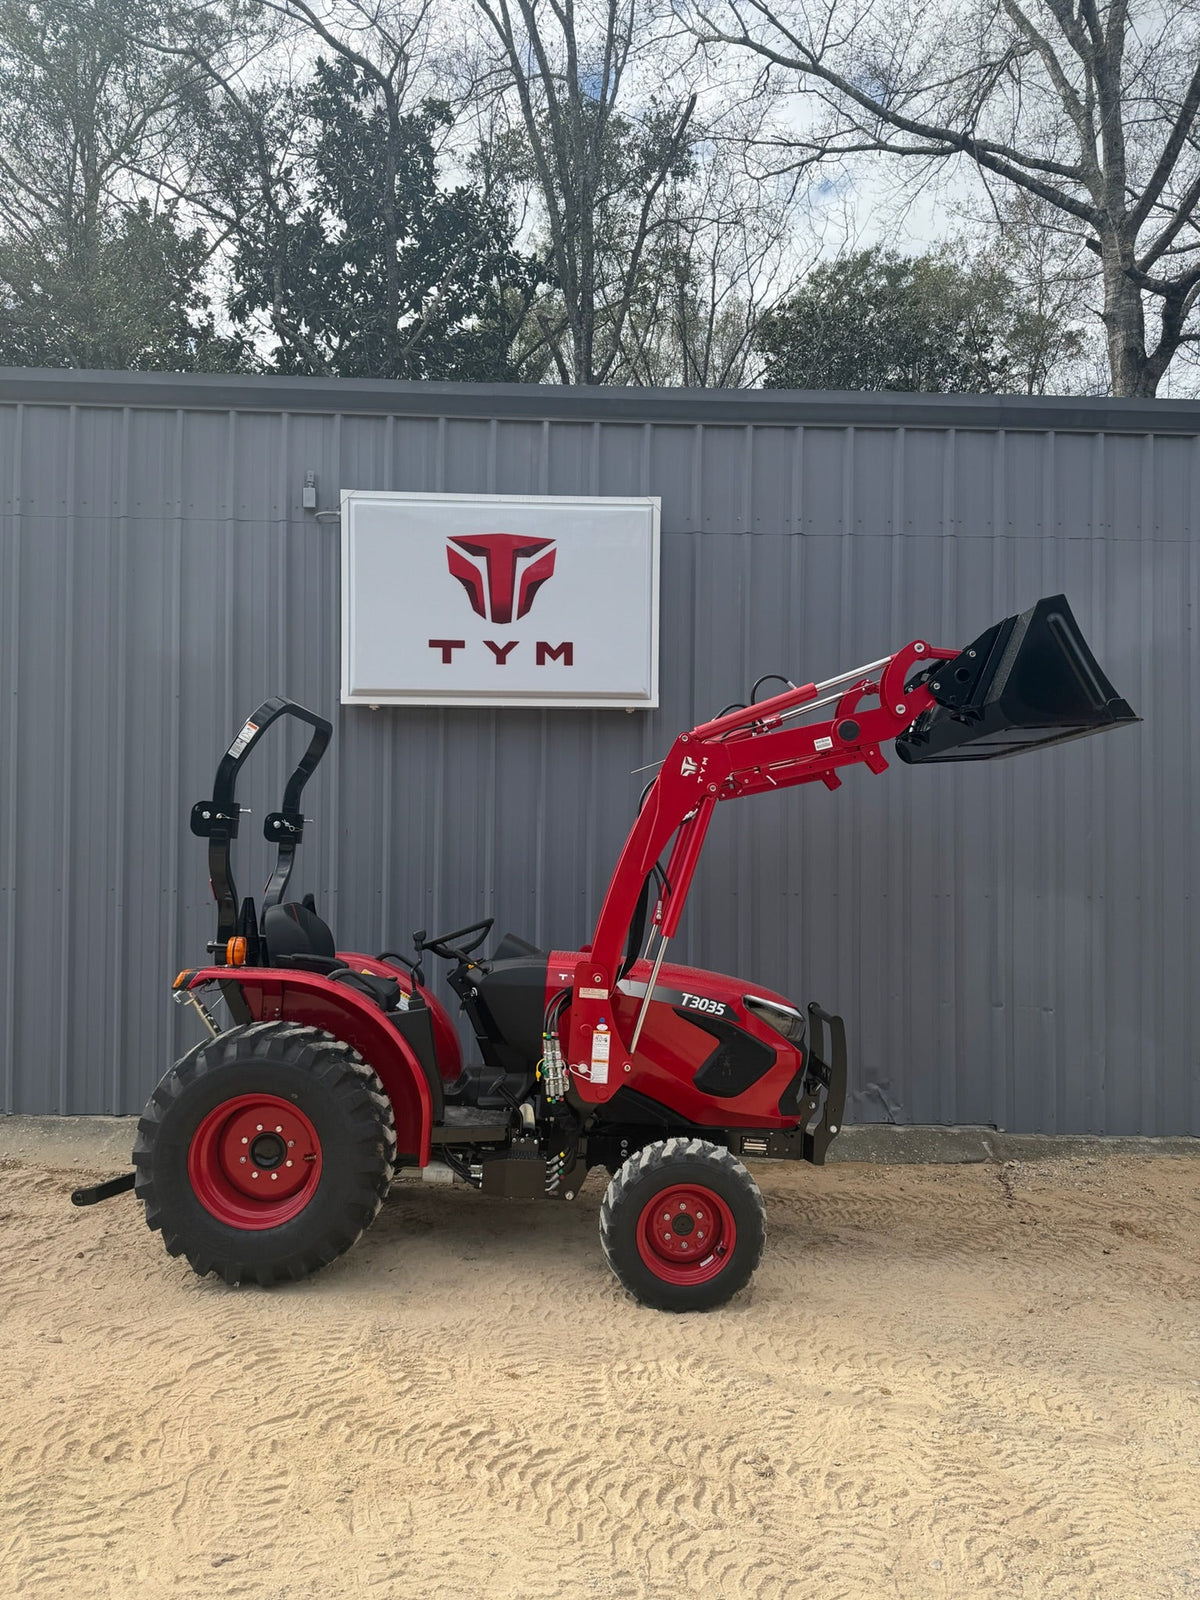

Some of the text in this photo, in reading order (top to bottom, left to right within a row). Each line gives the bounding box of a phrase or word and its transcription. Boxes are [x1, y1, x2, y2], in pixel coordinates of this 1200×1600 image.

[428, 639, 573, 666] TYM
[697, 757, 708, 784] TYM
[558, 973, 575, 981] T
[681, 992, 726, 1016] T3035
